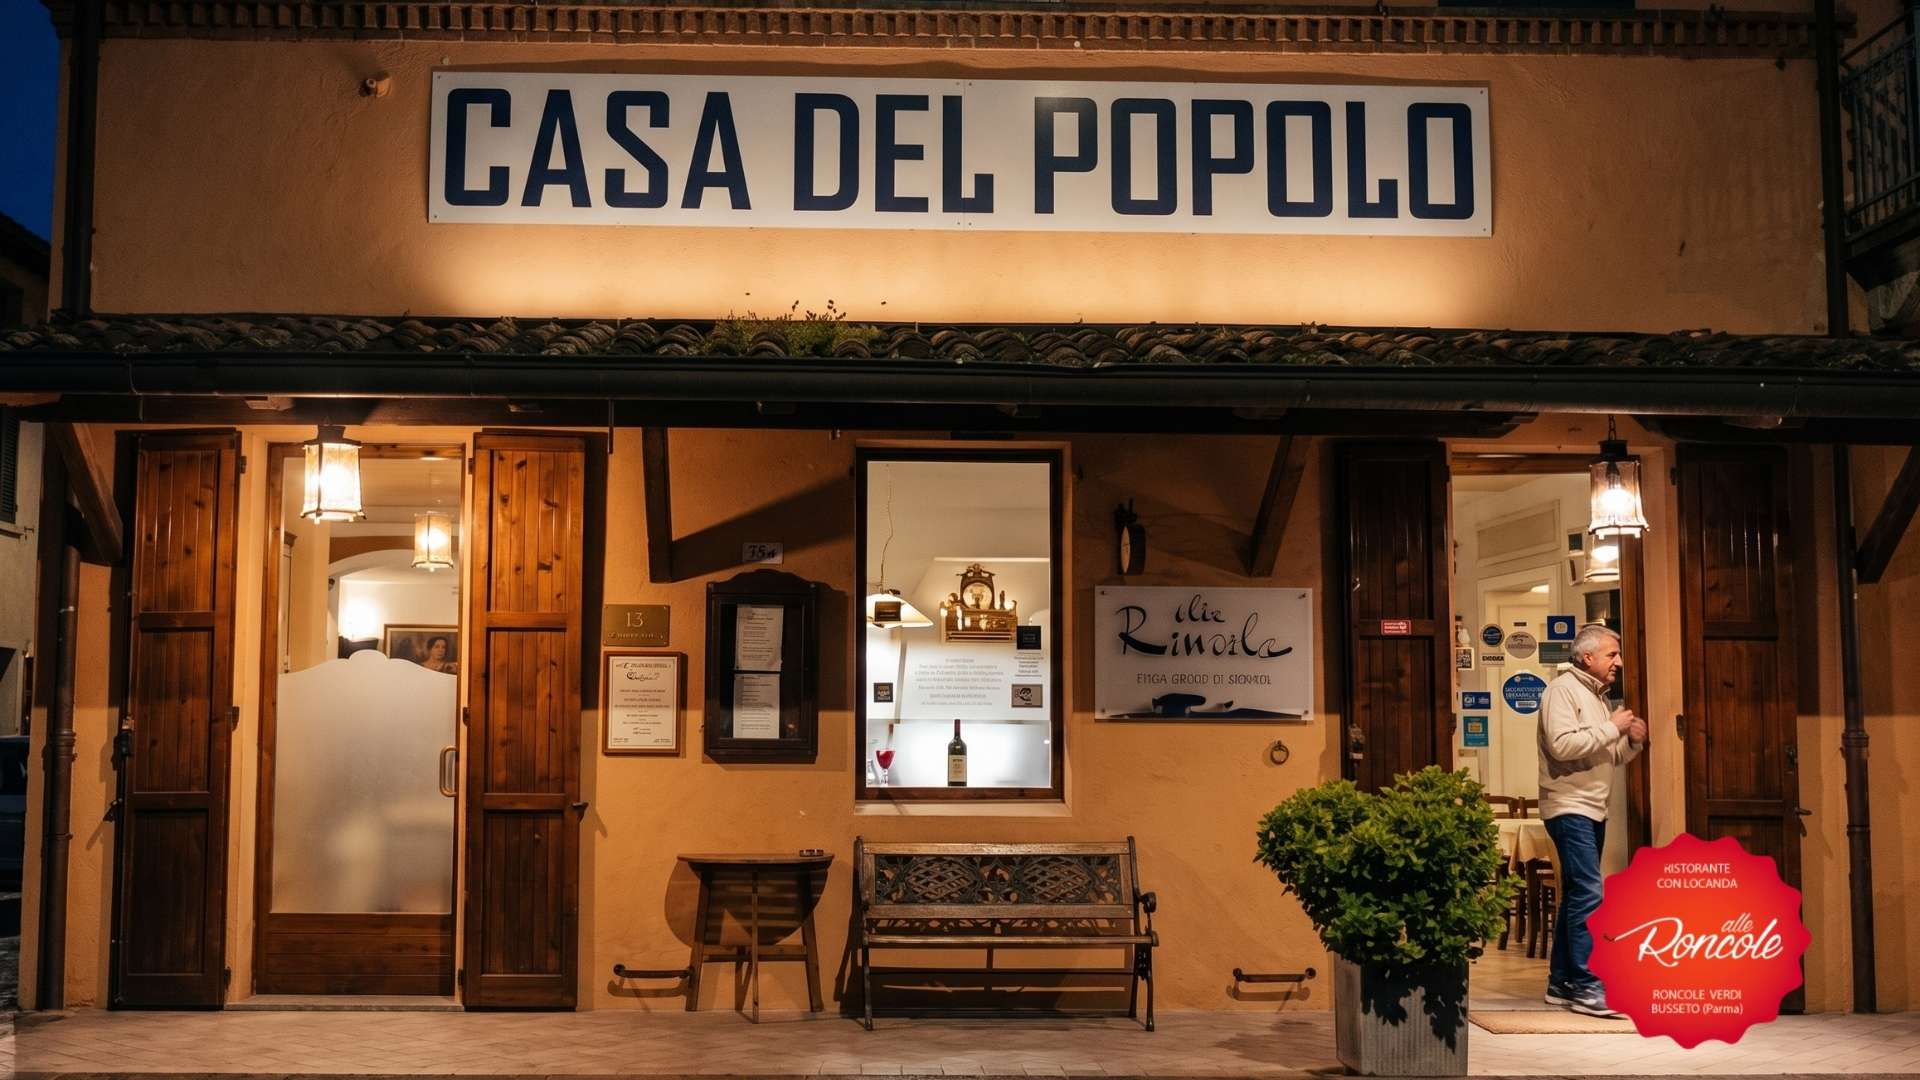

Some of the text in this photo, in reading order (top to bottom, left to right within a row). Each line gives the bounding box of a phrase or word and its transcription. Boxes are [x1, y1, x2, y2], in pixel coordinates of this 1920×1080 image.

[444, 87, 1475, 220] CASA DEL POPOLO
[626, 611, 644, 628] 13
